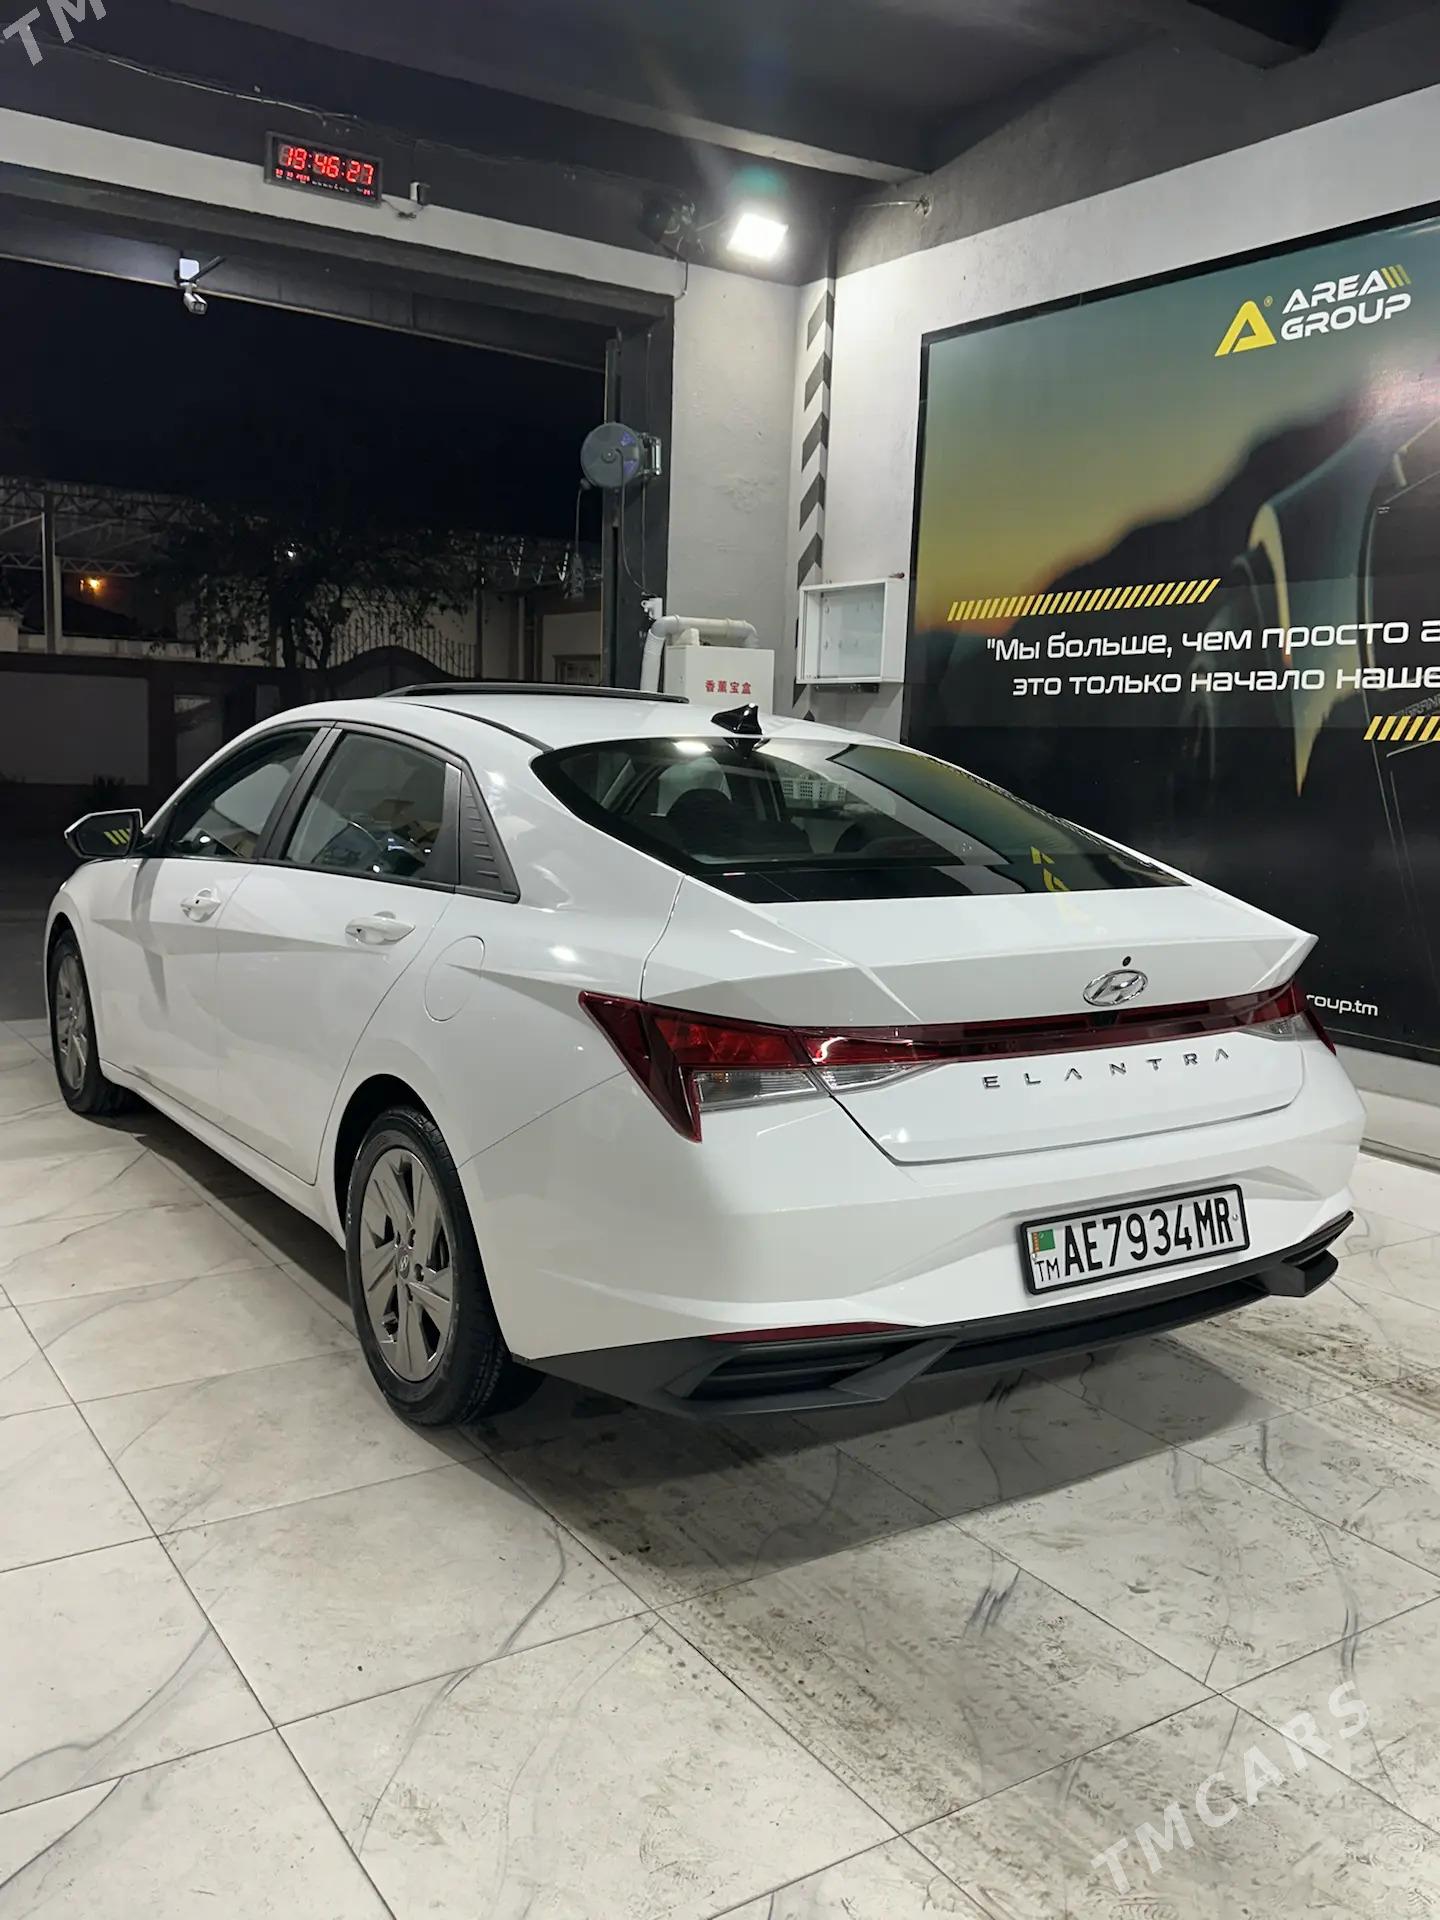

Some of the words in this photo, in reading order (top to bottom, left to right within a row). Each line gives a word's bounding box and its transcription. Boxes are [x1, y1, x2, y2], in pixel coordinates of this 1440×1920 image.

[287, 147, 374, 185] 19:46:27
[1282, 269, 1388, 314] AREA
[1281, 293, 1412, 341] GROUP
[986, 638, 1041, 661] "Мы
[1047, 631, 1173, 659] больше,
[1182, 629, 1252, 652] чем
[1261, 621, 1410, 656] просто
[1012, 676, 1062, 696] это
[1068, 673, 1183, 695] только
[1190, 669, 1326, 692] начало
[983, 1048, 1230, 1089] ELANTRA
[1034, 1257, 1061, 1282] TM
[1063, 1197, 1234, 1277] AE7934MR
